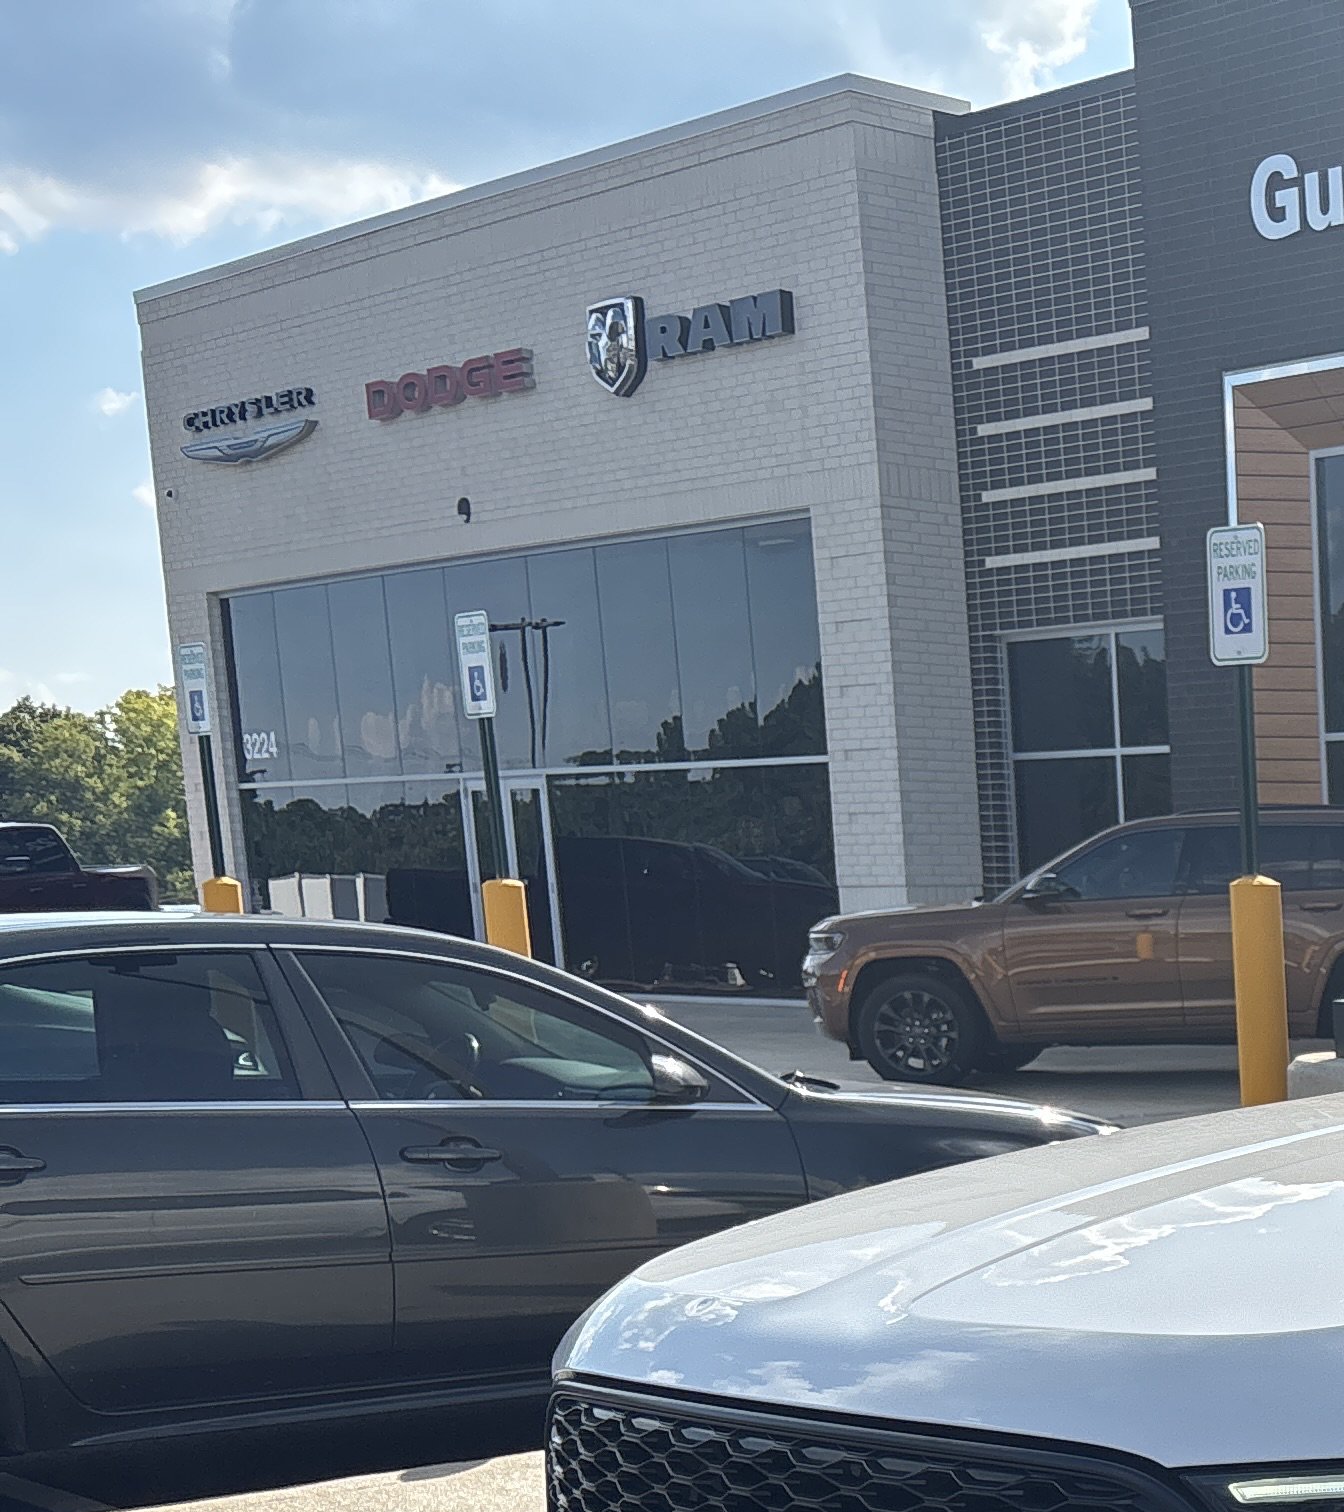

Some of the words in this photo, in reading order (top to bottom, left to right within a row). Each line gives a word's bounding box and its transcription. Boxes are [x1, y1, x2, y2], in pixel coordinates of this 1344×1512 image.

[645, 288, 796, 361] RAM
[365, 346, 536, 421] DODGE
[182, 386, 315, 434] CHRYSLER
[1212, 538, 1260, 559] RESERVED
[1216, 562, 1257, 582] PARKING
[242, 731, 278, 760] 3224
